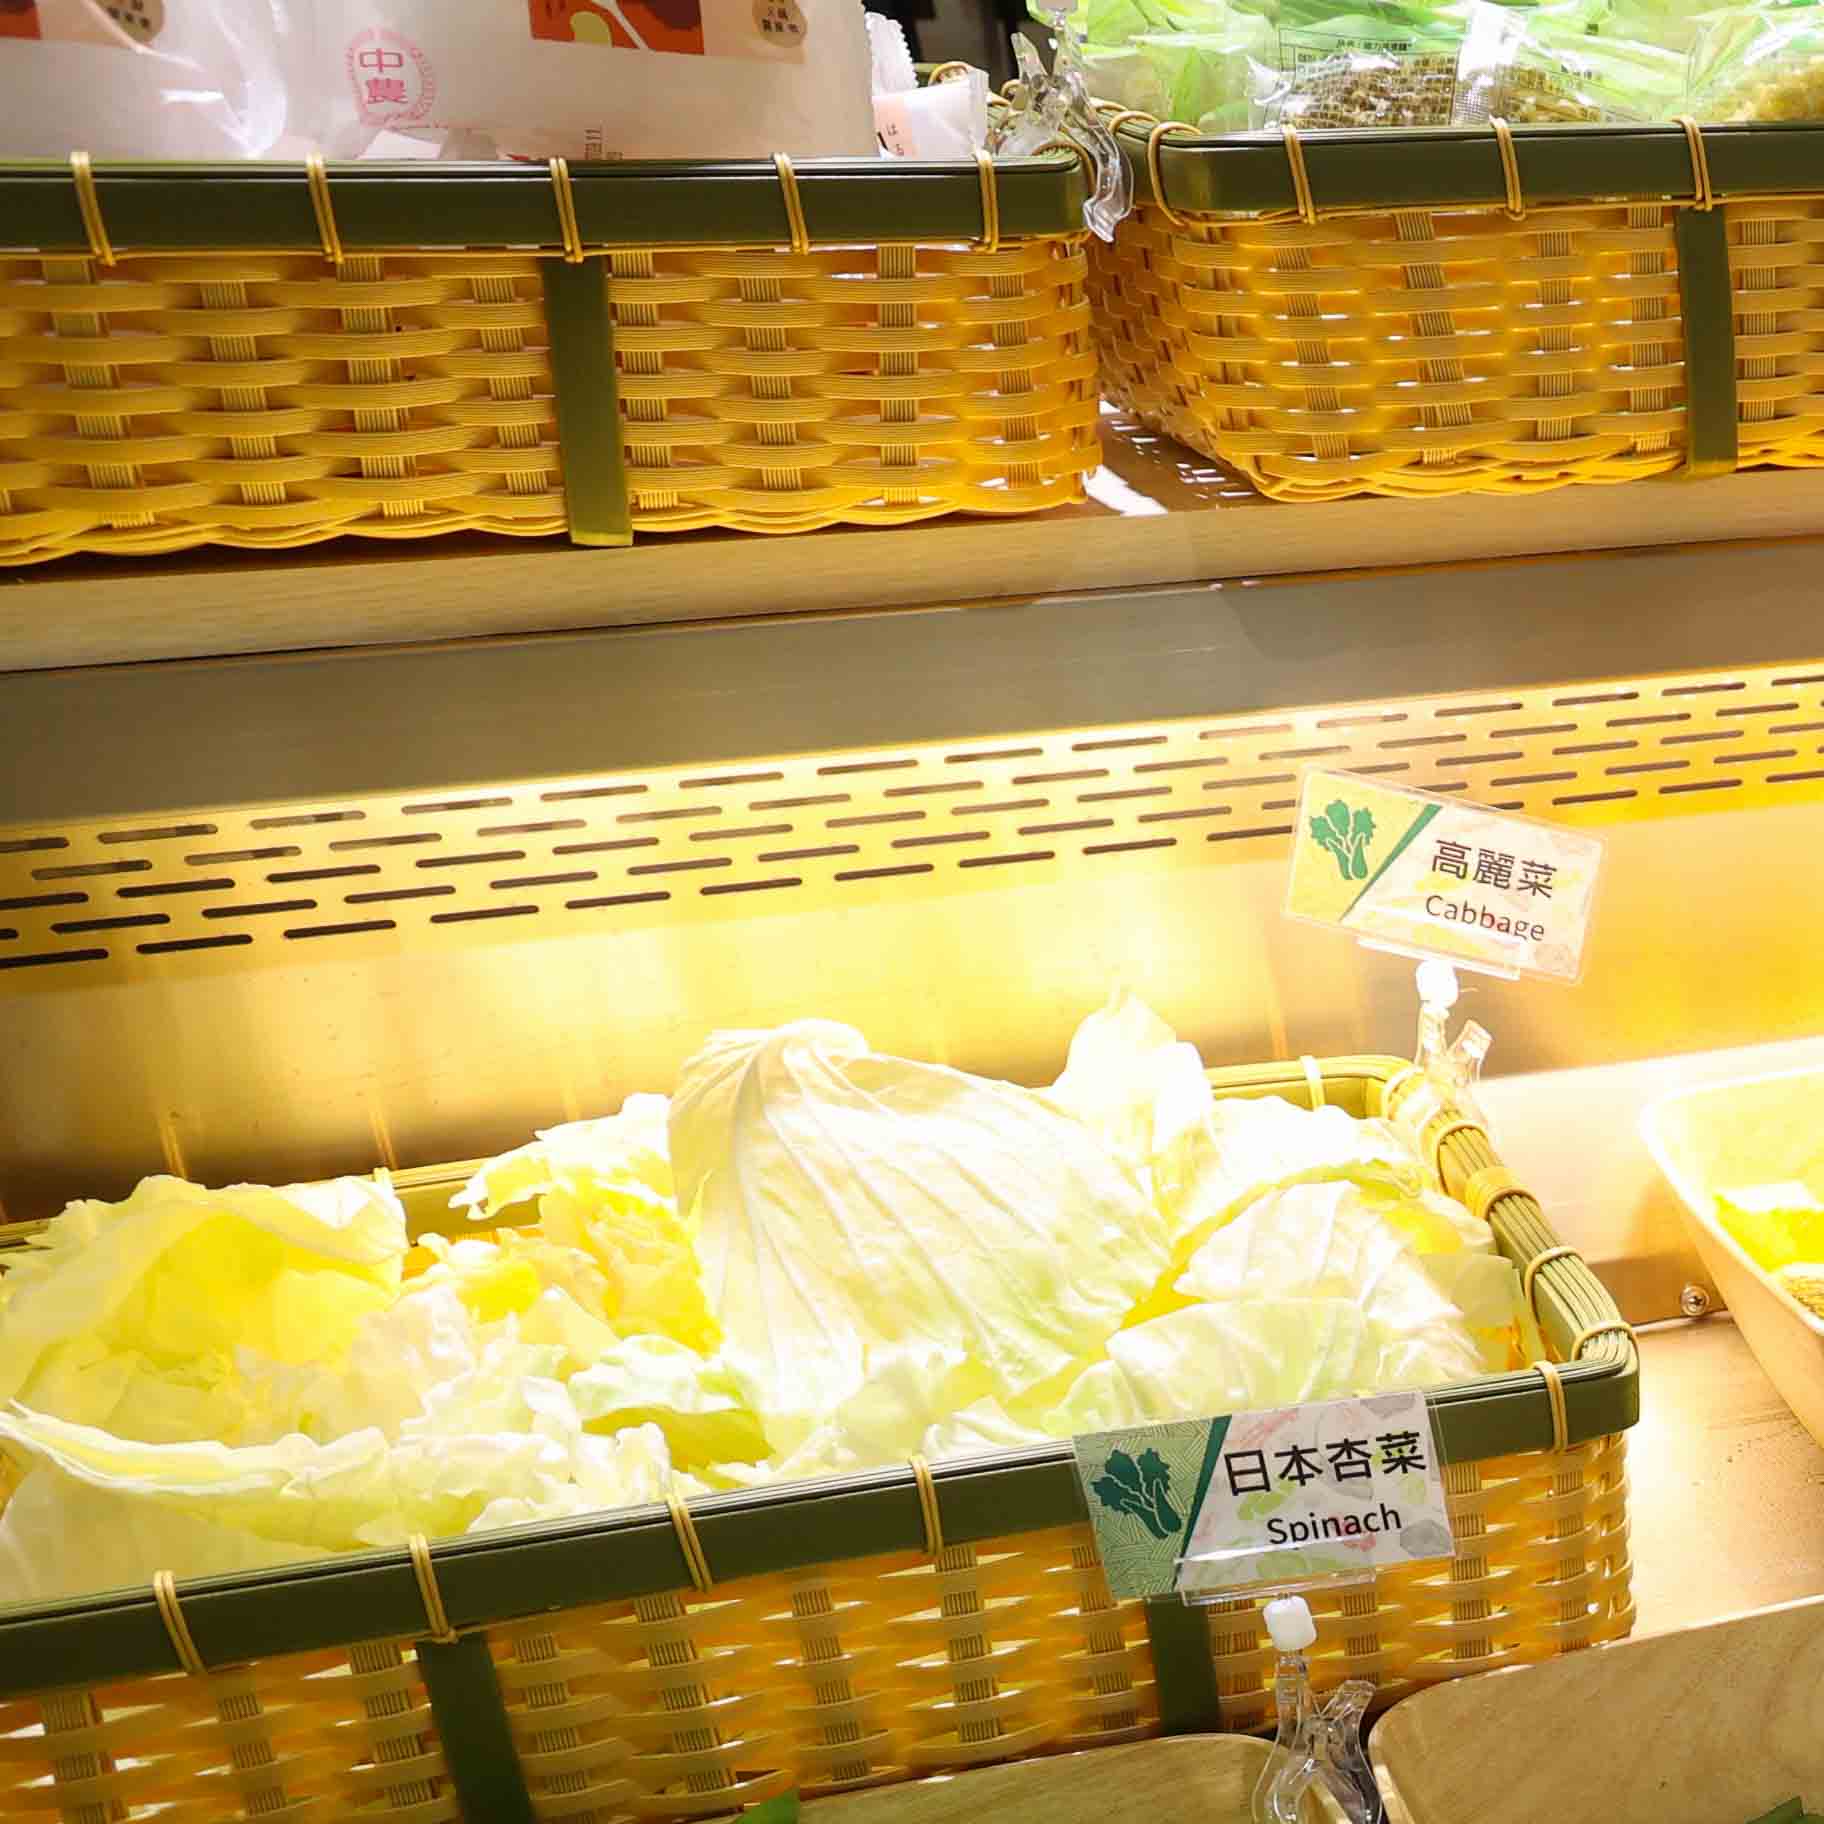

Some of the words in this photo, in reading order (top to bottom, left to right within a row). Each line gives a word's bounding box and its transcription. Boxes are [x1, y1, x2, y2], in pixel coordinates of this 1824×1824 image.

[1430, 838, 1559, 899] 高麗菜
[1424, 894, 1546, 942] Cabbage
[1223, 1430, 1427, 1497] 日本杏菜
[1266, 1502, 1402, 1545] Spinach
